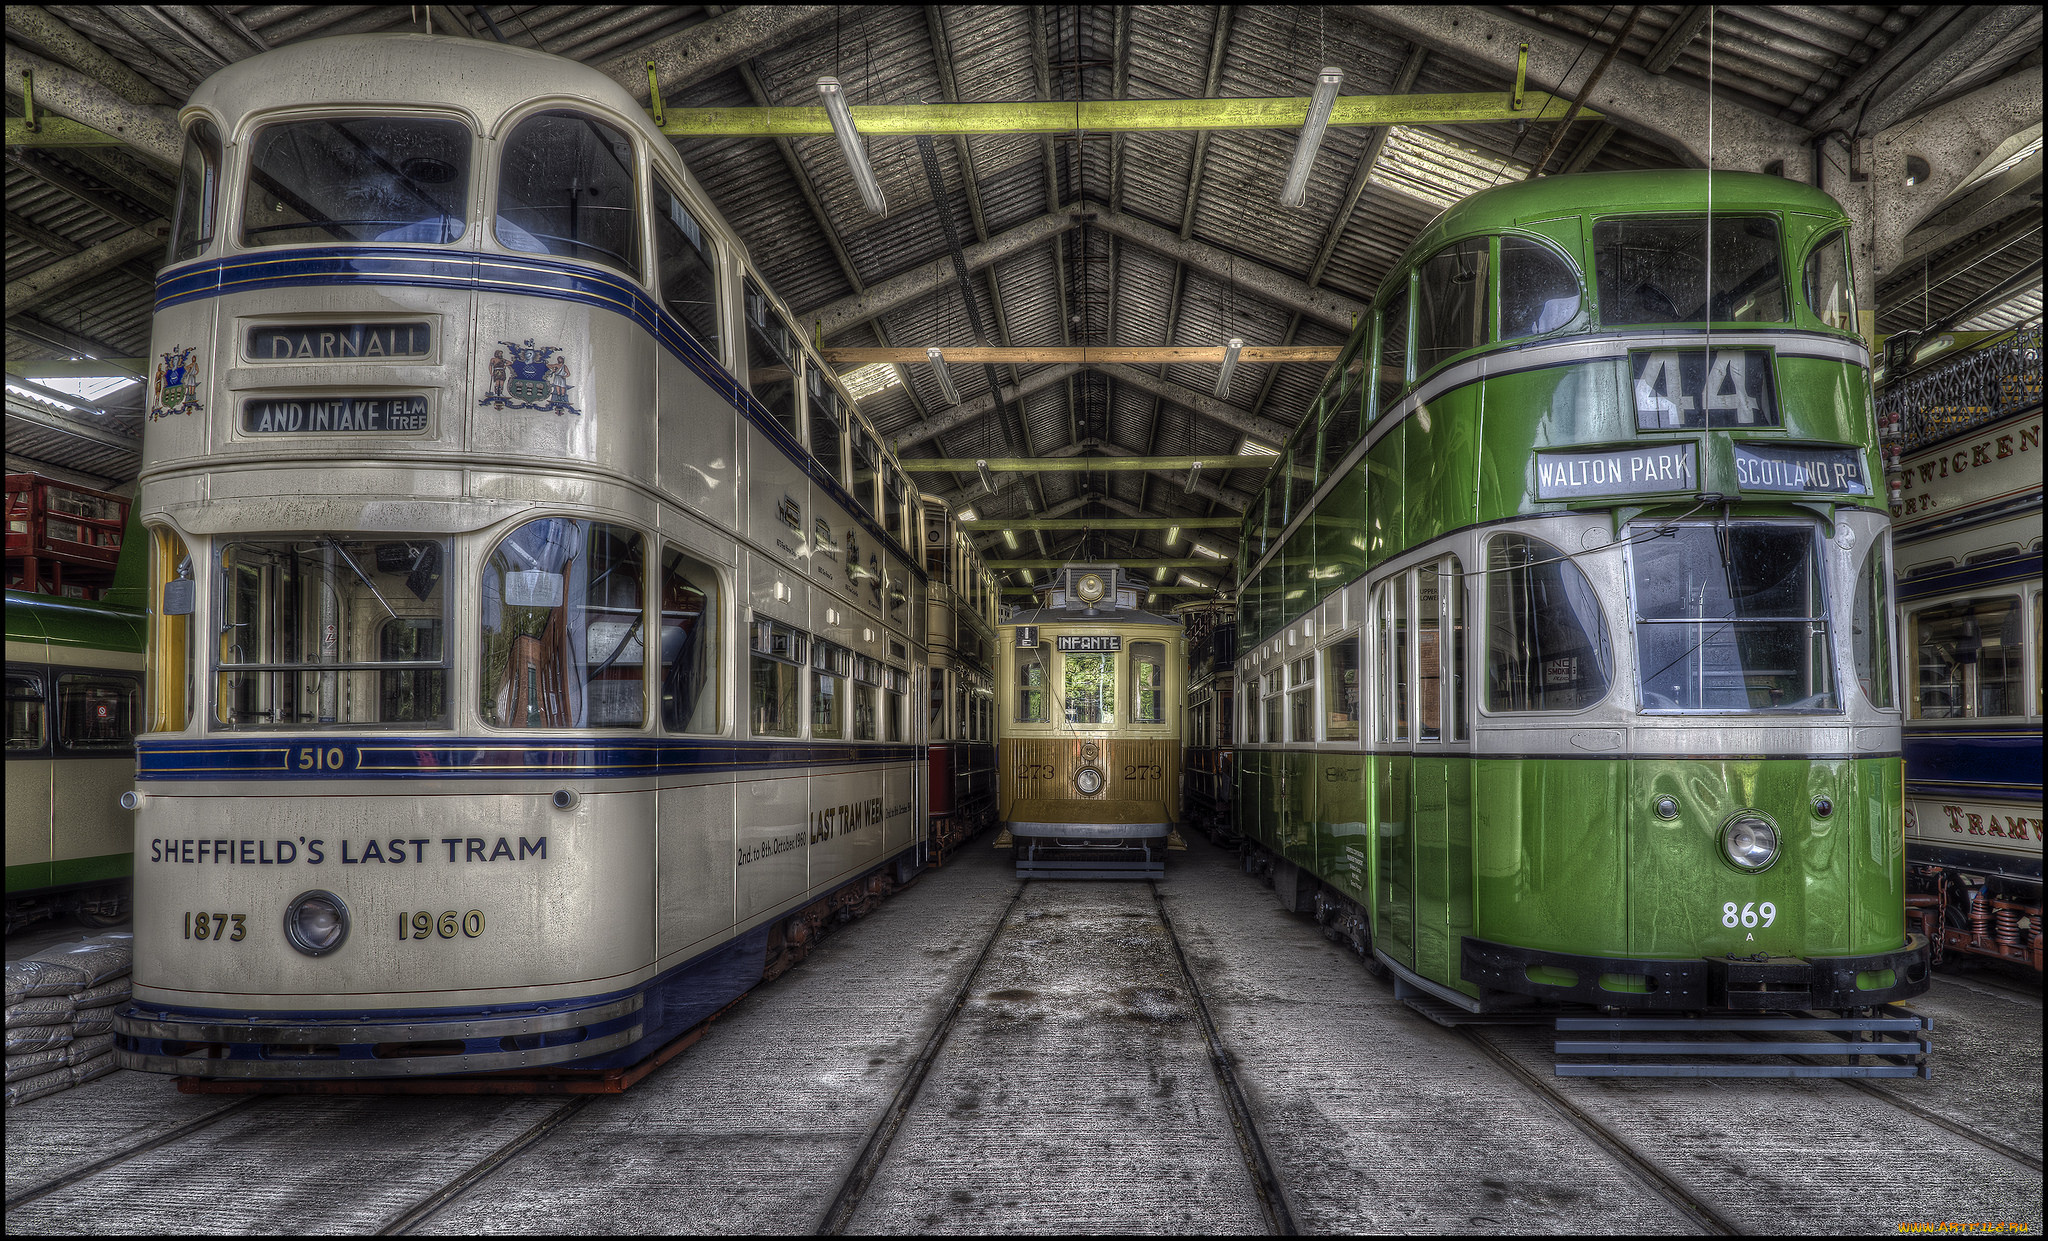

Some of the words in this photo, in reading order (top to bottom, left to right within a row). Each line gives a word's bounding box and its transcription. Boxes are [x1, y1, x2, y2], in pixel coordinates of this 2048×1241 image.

[271, 328, 424, 359] DARNALL
[1634, 349, 1760, 425] 44
[258, 403, 303, 432] AND
[308, 401, 379, 431] INTAKE
[393, 400, 427, 415] ELM
[390, 415, 427, 431] TREE
[1537, 459, 1622, 488] WALTON
[1630, 452, 1691, 483] PARK
[1736, 457, 1830, 488] SCOTLAND
[1058, 636, 1120, 650] INFANTE
[298, 747, 345, 770] 510
[1017, 764, 1055, 780] 273
[1124, 764, 1162, 780] 273
[810, 808, 836, 845] LAST
[838, 802, 862, 836] TRAM
[864, 797, 884, 827] WEEK
[151, 835, 325, 865] SHEFFIELD'S
[341, 838, 430, 864] LAST
[441, 836, 548, 862] TRAM
[738, 845, 753, 866] 2nd.
[753, 848, 760, 861] to
[183, 911, 248, 941] 1873
[398, 909, 487, 940] 1960
[1722, 901, 1777, 928] 869
[1745, 932, 1755, 942] A
